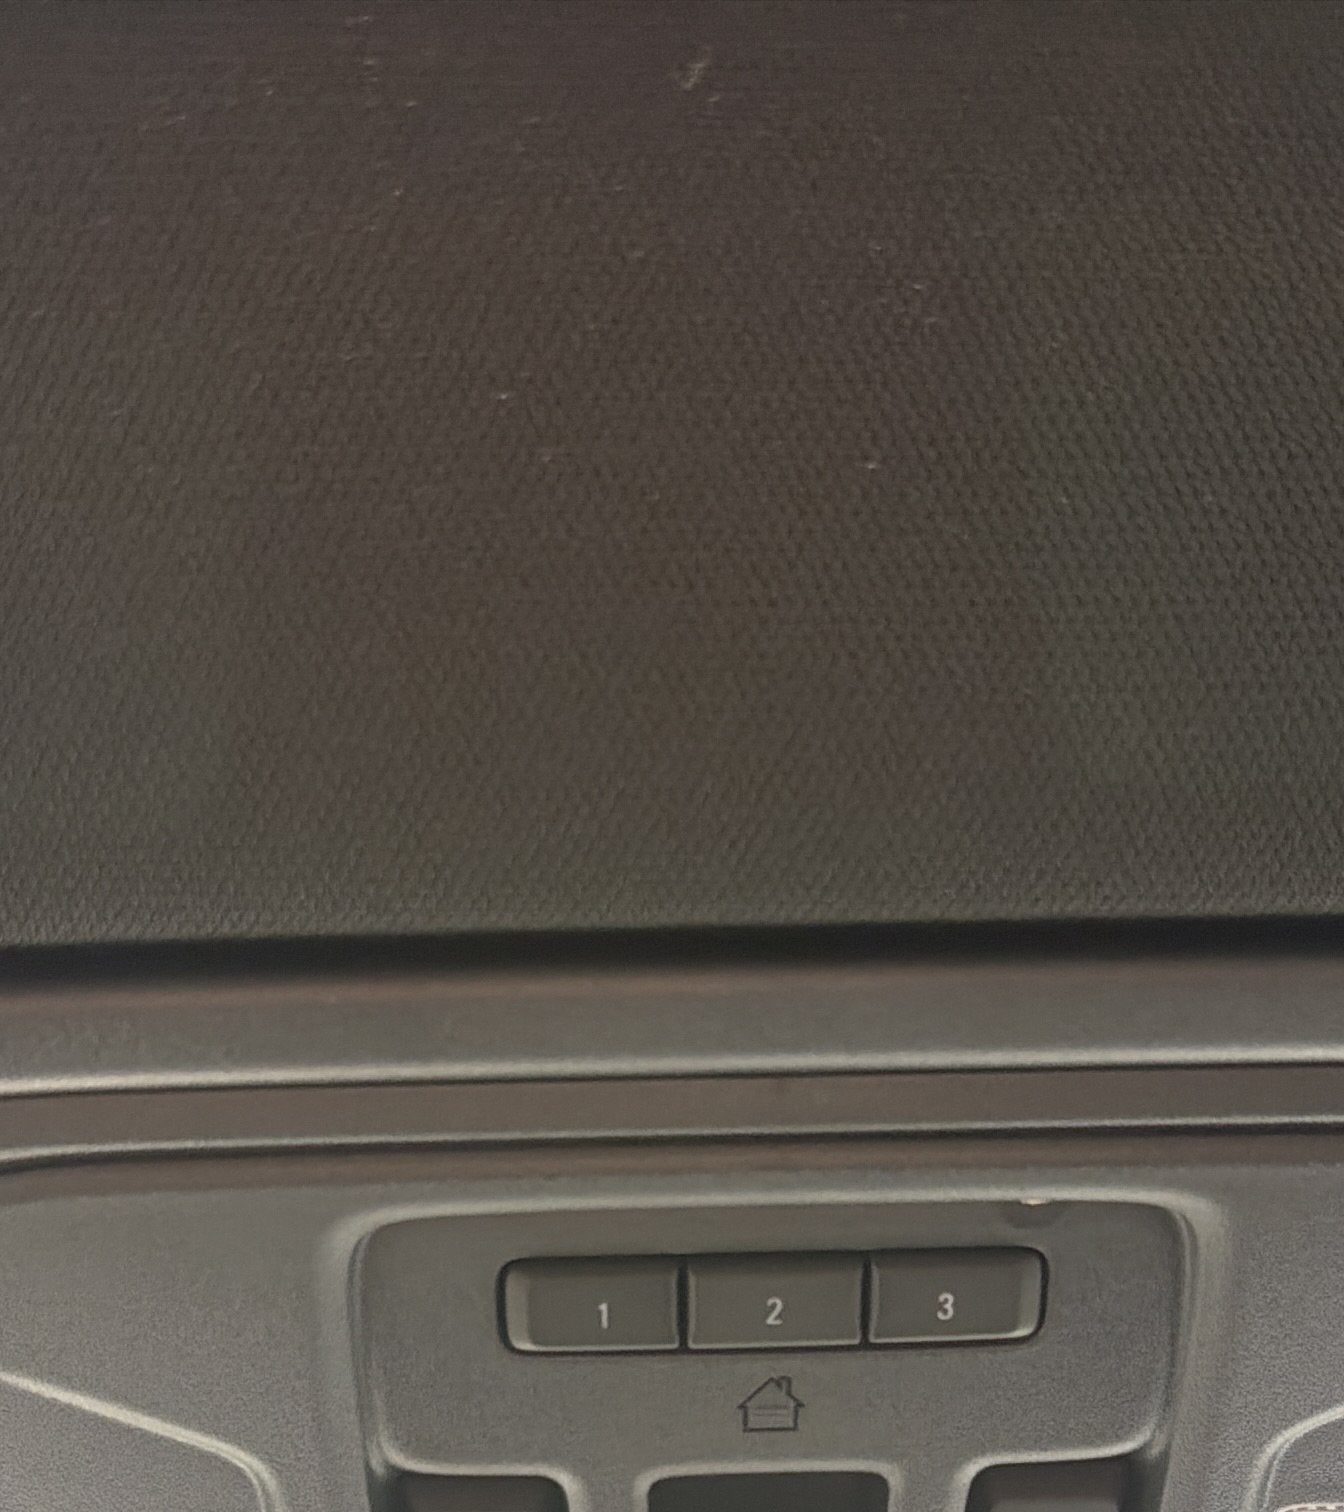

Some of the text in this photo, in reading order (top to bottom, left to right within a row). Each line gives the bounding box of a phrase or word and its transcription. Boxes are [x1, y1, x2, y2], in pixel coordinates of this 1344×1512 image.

[597, 1301, 610, 1330] 1
[764, 1297, 784, 1326] 2
[935, 1292, 955, 1321] 3
